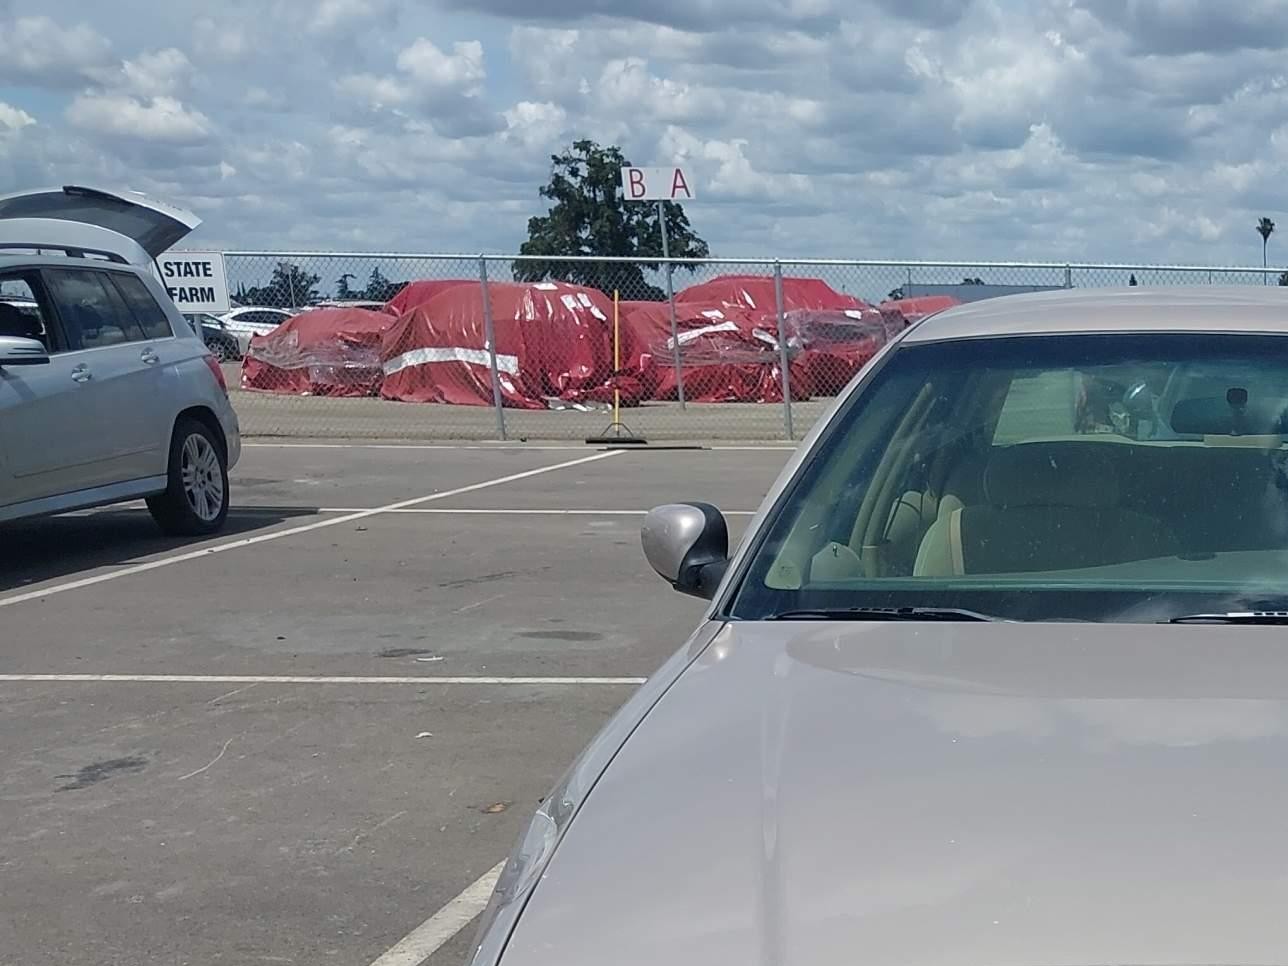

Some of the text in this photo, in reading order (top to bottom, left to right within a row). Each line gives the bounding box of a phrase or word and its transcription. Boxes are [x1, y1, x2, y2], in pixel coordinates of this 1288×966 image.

[629, 168, 691, 198] B A
[163, 261, 213, 278] STATE
[167, 286, 216, 303] FARM
